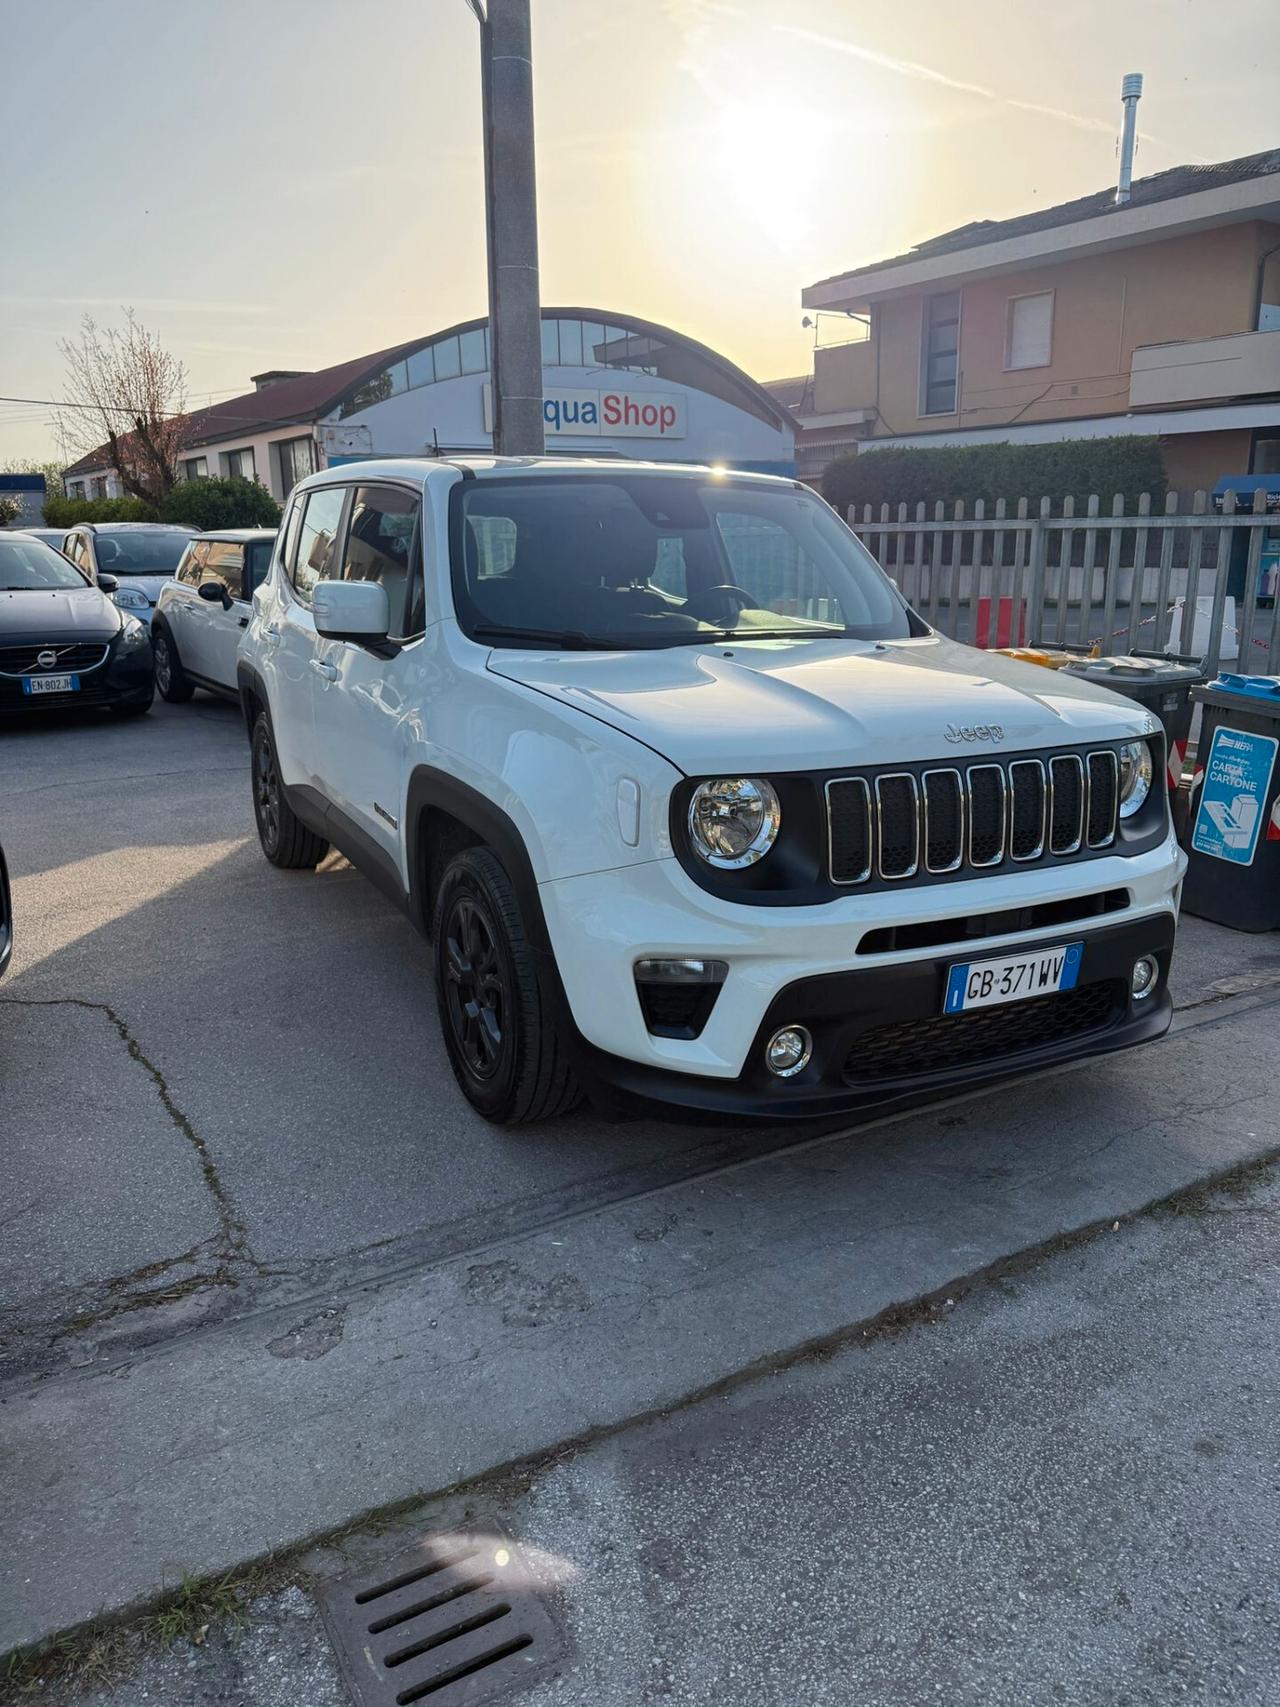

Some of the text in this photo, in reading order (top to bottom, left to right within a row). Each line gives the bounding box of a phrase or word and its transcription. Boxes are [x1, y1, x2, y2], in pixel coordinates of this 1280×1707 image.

[543, 394, 676, 434] qua Shop
[944, 723, 1004, 744] Jeep
[1212, 760, 1245, 777] CARTA
[1210, 771, 1257, 792] CARTONE
